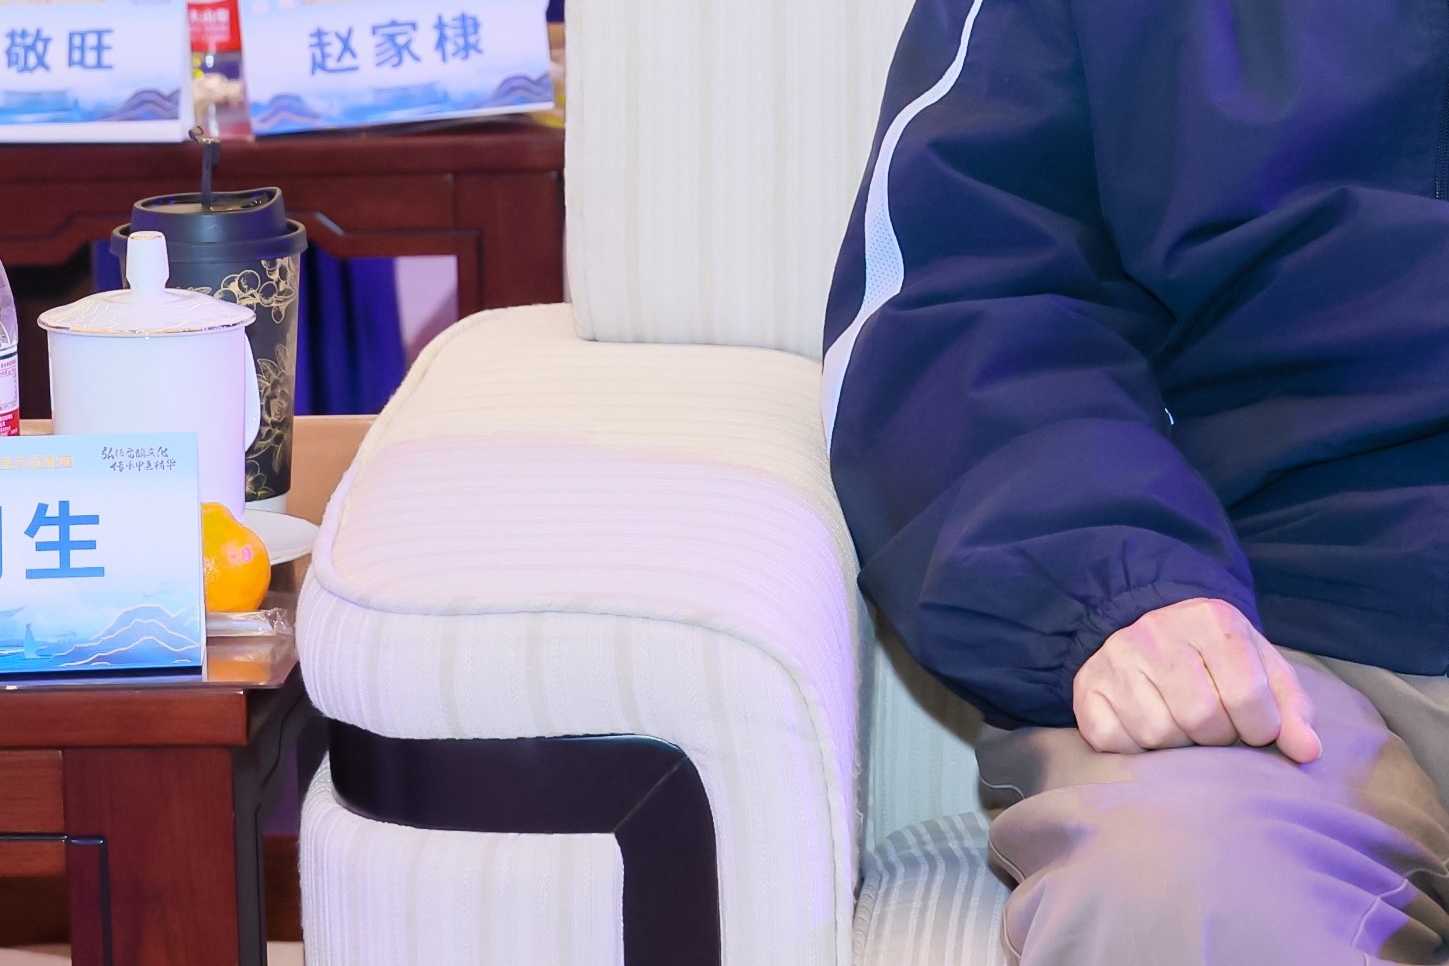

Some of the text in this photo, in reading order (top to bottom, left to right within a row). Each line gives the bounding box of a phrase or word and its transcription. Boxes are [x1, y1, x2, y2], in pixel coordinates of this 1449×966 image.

[5, 28, 114, 73] 敬旺
[309, 11, 483, 76] 赵家棣
[0, 500, 105, 579] 生
